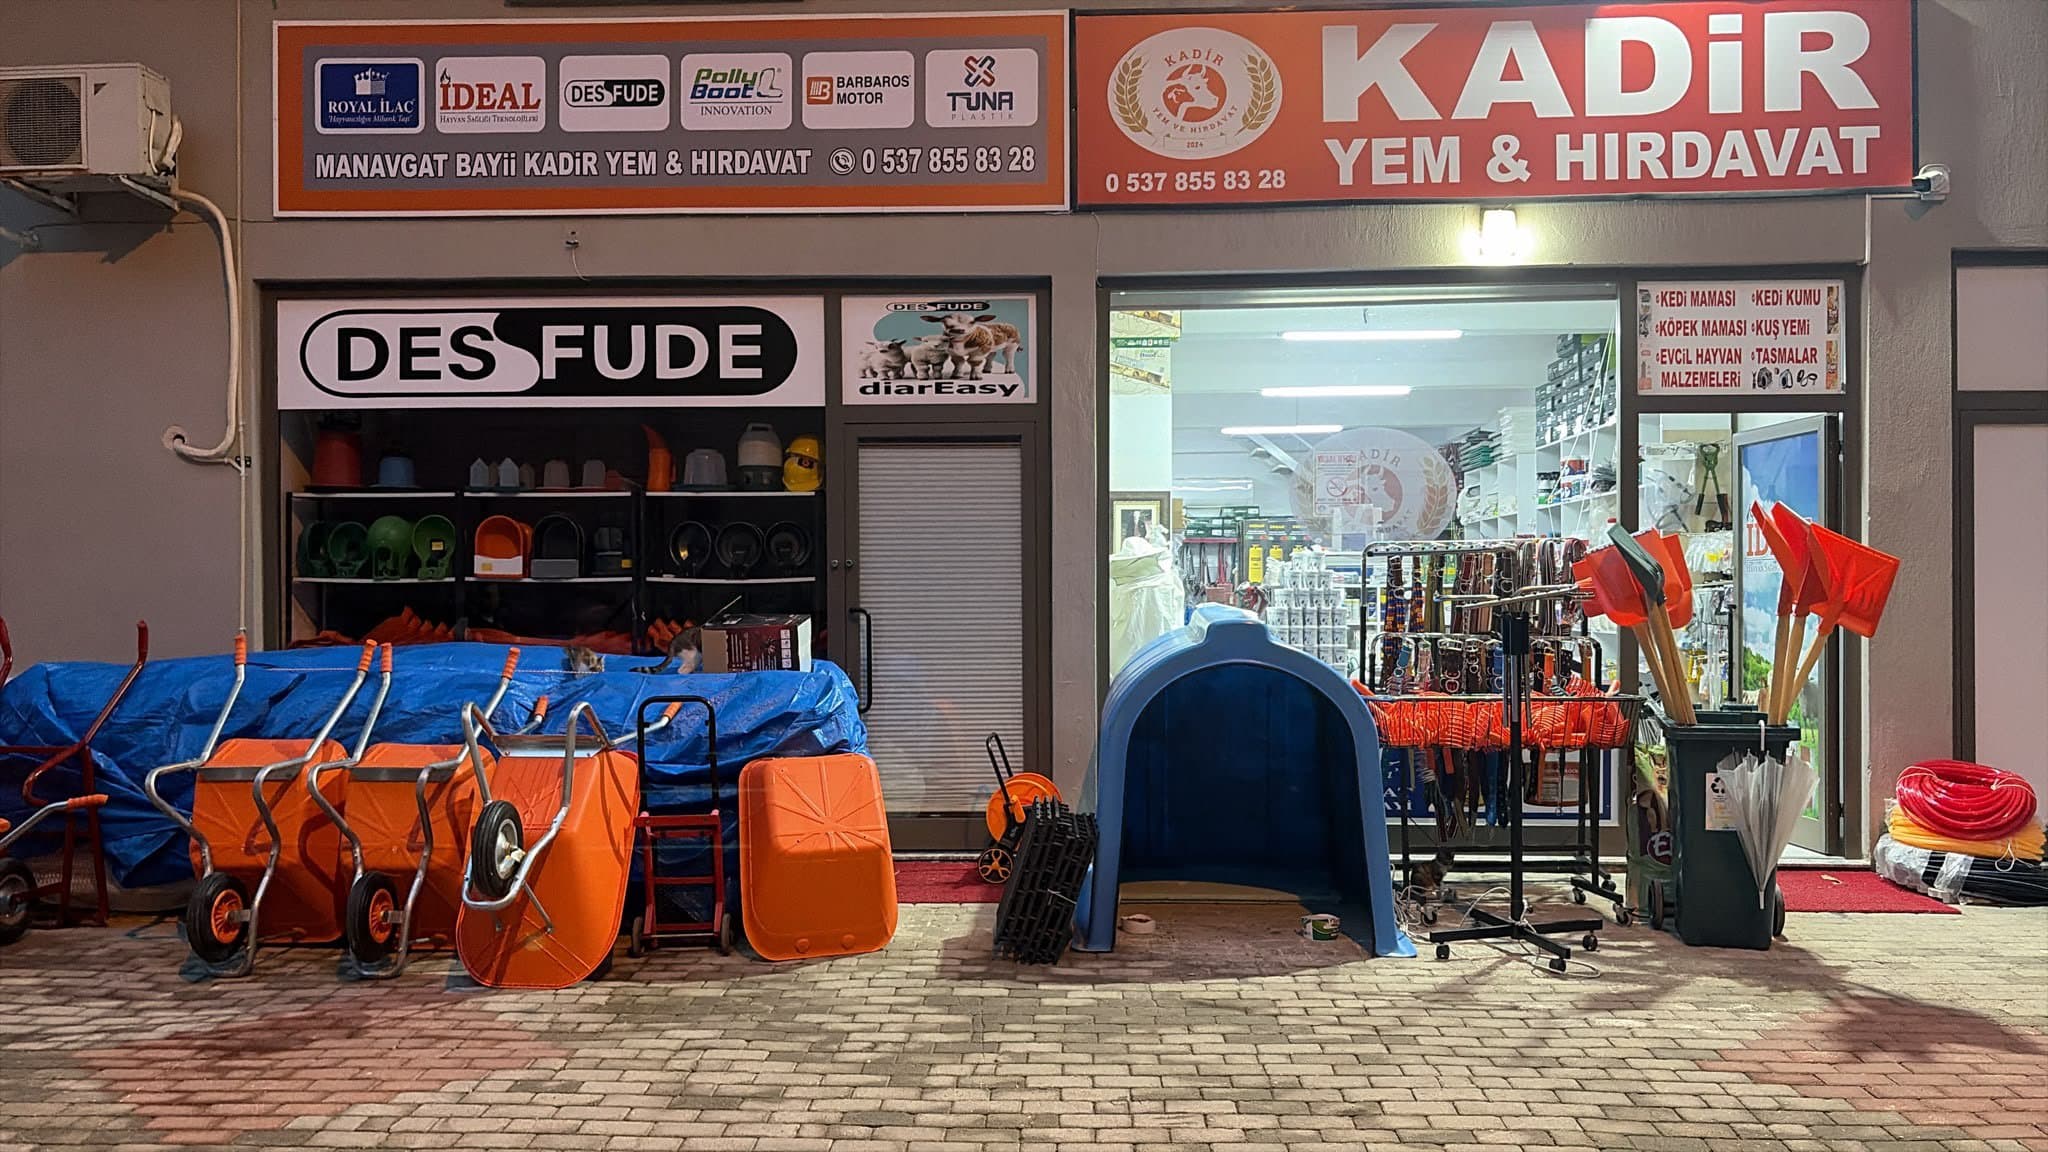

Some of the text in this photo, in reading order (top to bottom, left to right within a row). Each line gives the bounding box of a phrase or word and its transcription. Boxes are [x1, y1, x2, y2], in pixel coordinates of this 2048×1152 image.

[694, 68, 758, 86] Polly
[837, 75, 910, 88] BARBAROS
[571, 83, 659, 102] DES FUDE
[690, 84, 754, 99] Boot
[837, 92, 883, 104] MOTOR
[328, 101, 376, 113] ROYAL
[947, 91, 1013, 111] TUNA
[701, 105, 772, 116] INNOVATION
[315, 153, 449, 178] MANAVGAT
[605, 150, 657, 176] YEM
[665, 150, 683, 176] &
[691, 150, 812, 175] HIRDAVAT
[862, 149, 877, 174] 0
[881, 148, 922, 173] 537
[928, 148, 969, 173] 855
[975, 147, 1002, 172] 83
[1008, 146, 1036, 172] 28
[1324, 126, 1881, 186] YEM & HIRDAVAT
[1105, 169, 1286, 193] 0 537 855 83 28
[1690, 290, 1736, 307] MAMASI
[1786, 289, 1821, 306] KUMU
[893, 302, 984, 311] DES FUDE
[1659, 317, 1747, 337] KÖPEK MAMASI
[1755, 319, 1779, 340] KUŞ
[337, 324, 763, 381] DES FUDE
[1696, 348, 1742, 365] HAYVAN
[1755, 347, 1818, 364] TASMALAR
[859, 381, 1019, 397] diarEasy
